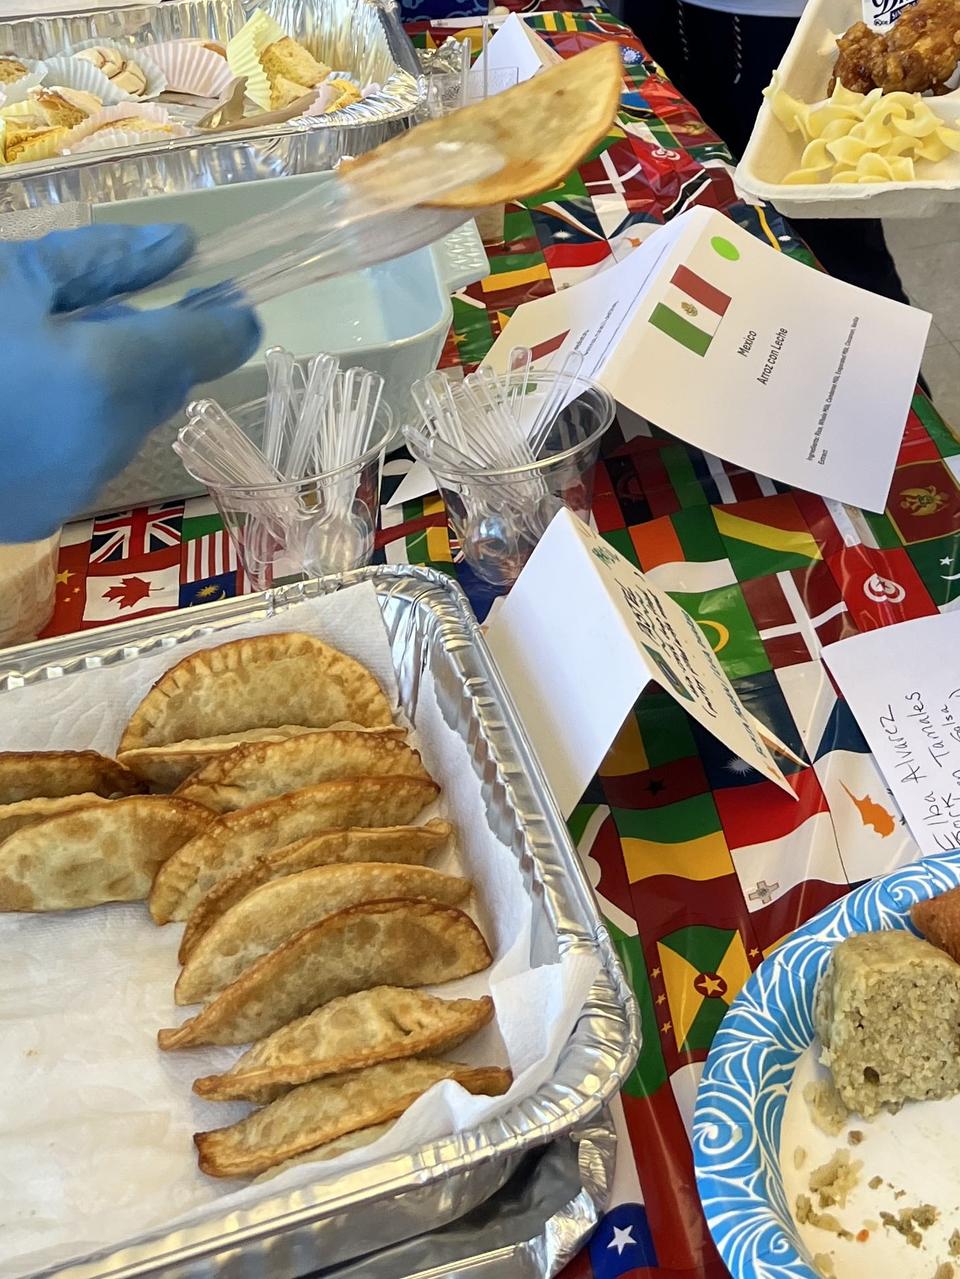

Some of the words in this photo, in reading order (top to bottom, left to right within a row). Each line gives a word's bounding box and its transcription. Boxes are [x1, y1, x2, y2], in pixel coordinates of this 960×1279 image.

[737, 330, 757, 357] Mexico
[771, 328, 788, 350] Leche
[767, 349, 779, 365] con
[757, 363, 774, 385] Arroz
[905, 691, 950, 767] Tamales
[879, 704, 927, 784] Alvarez
